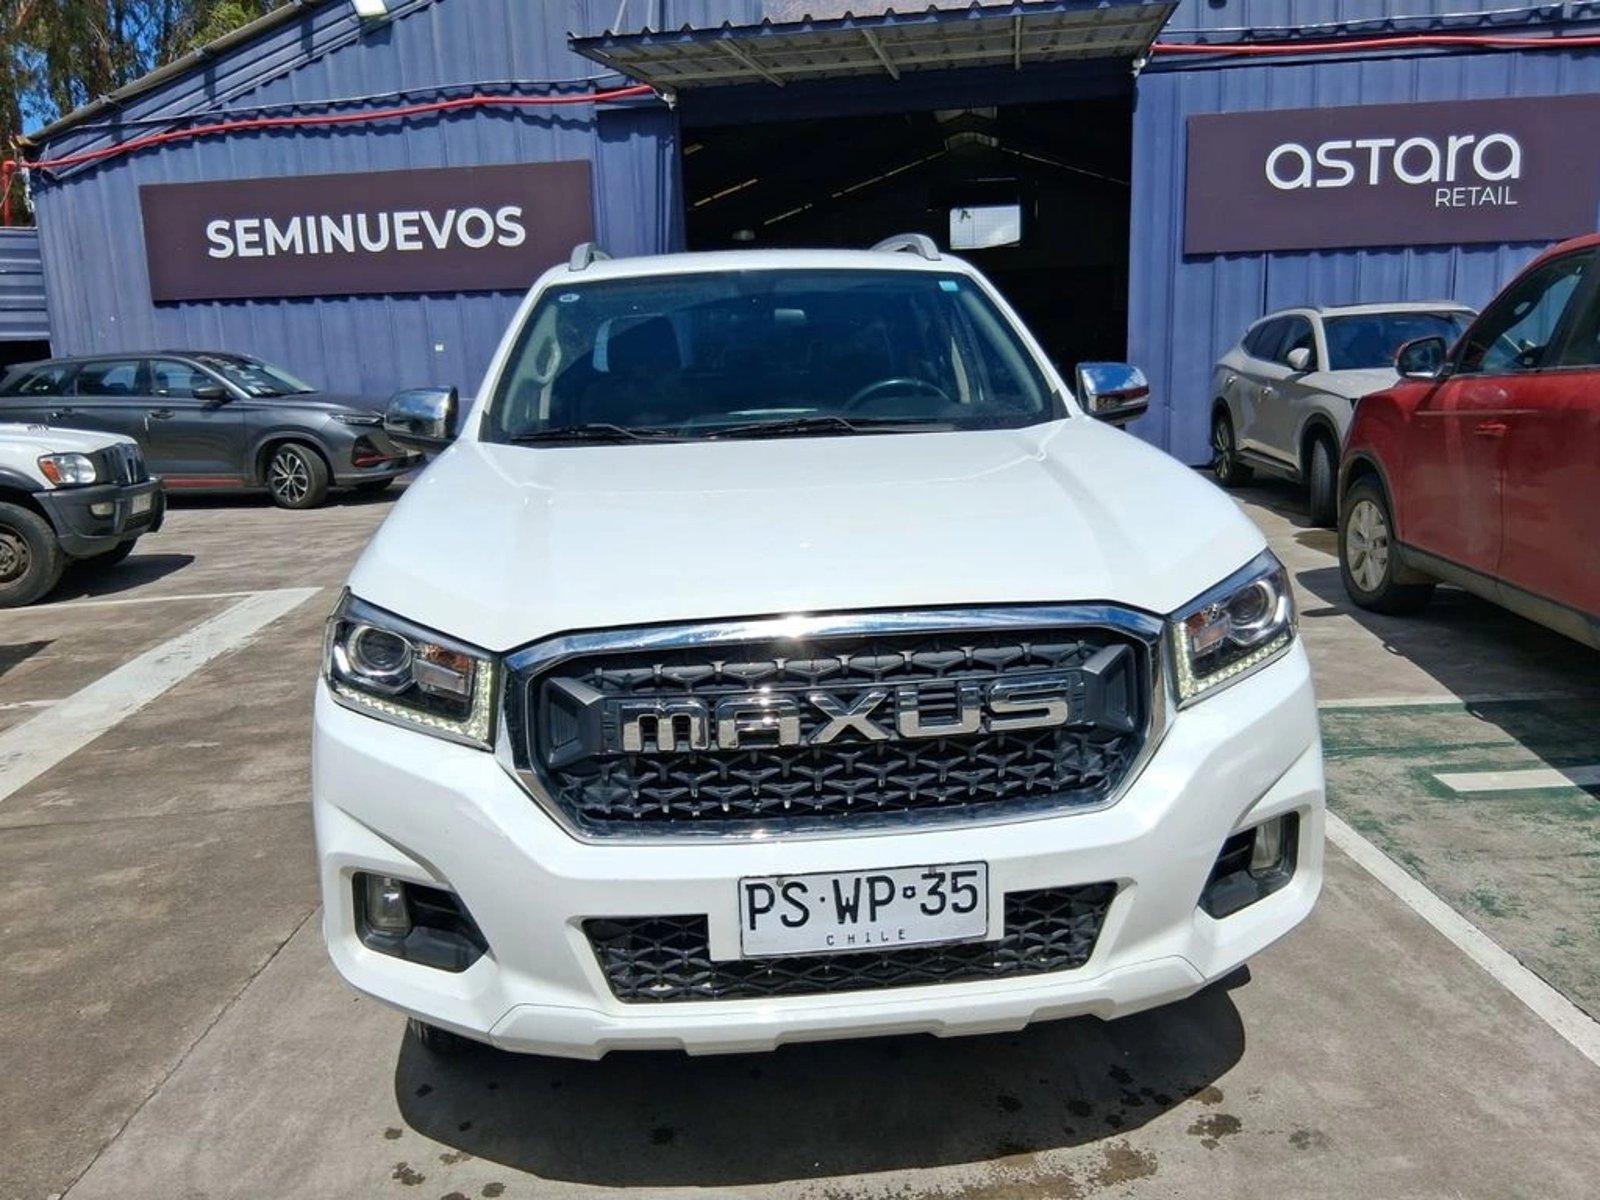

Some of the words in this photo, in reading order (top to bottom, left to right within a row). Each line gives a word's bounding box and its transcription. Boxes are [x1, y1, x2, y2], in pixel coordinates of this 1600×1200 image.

[1435, 186, 1518, 207] RETAIL
[206, 205, 526, 259] SEMINUEVOS
[621, 672, 1070, 752] MAXUS
[826, 928, 906, 946] CHILE
